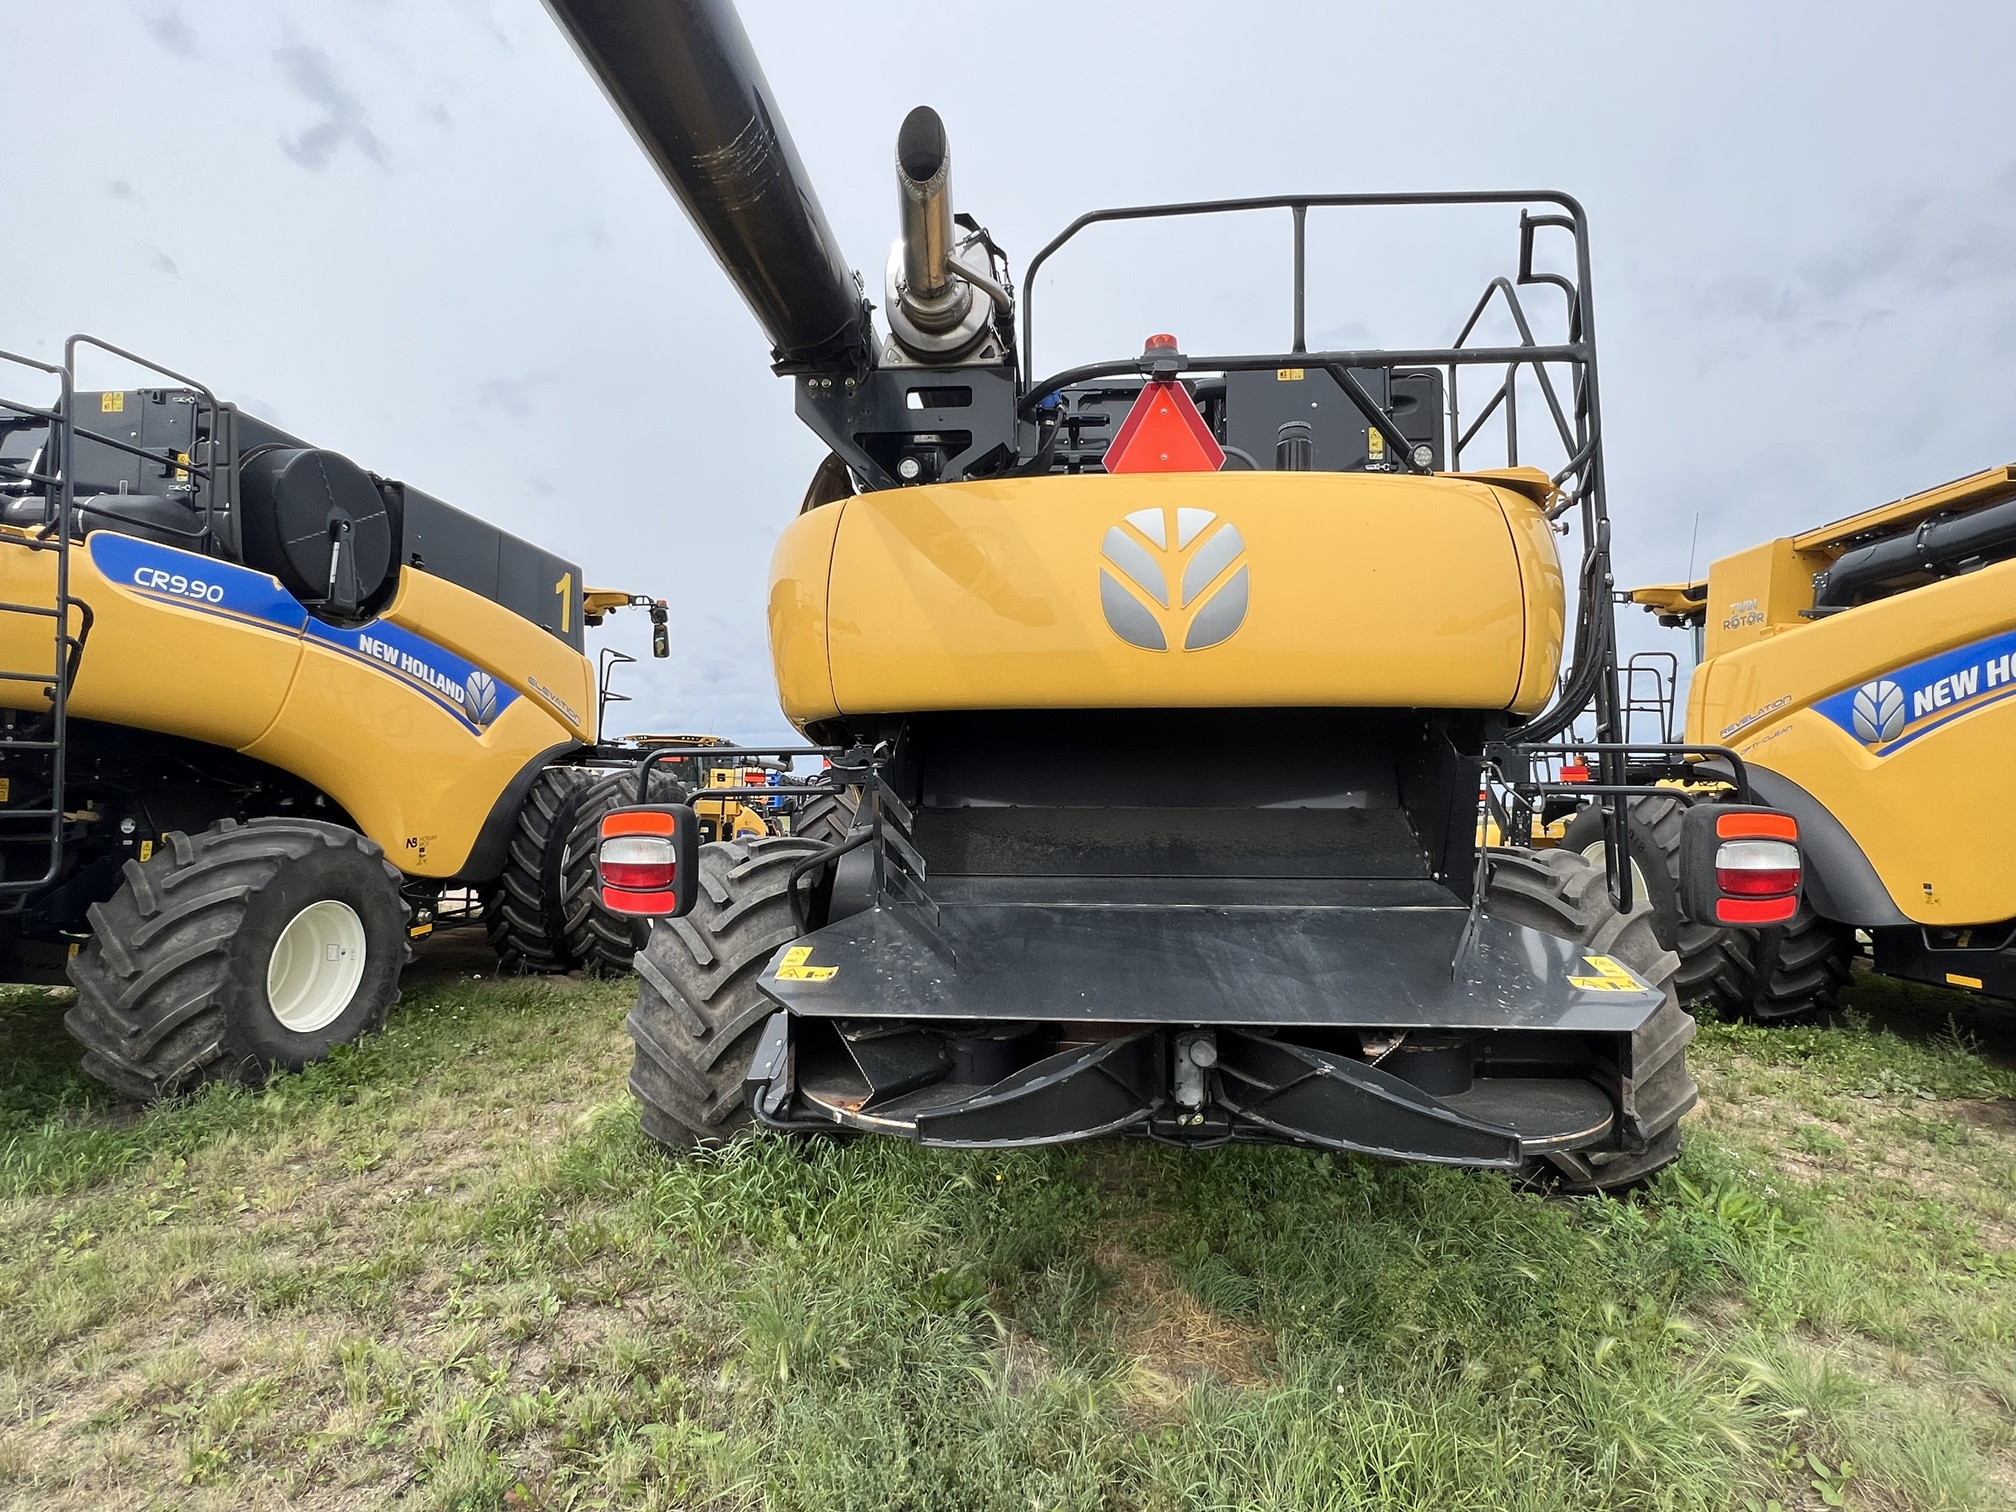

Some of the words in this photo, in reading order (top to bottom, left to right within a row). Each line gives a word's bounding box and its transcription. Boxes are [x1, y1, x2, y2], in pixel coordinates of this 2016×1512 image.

[134, 567, 224, 603] CR9.90
[555, 572, 571, 633] 1
[1729, 598, 1757, 614] TWIN
[1723, 611, 1764, 630] ROTOR
[359, 633, 399, 666] NEW
[400, 652, 465, 704] HOLLAND
[1913, 665, 1979, 717] NEW
[1986, 652, 2016, 688] H
[527, 676, 581, 724] ELEVATION
[1720, 694, 1792, 736] REVELATION
[1740, 724, 1793, 755] OPTI-CLEAN
